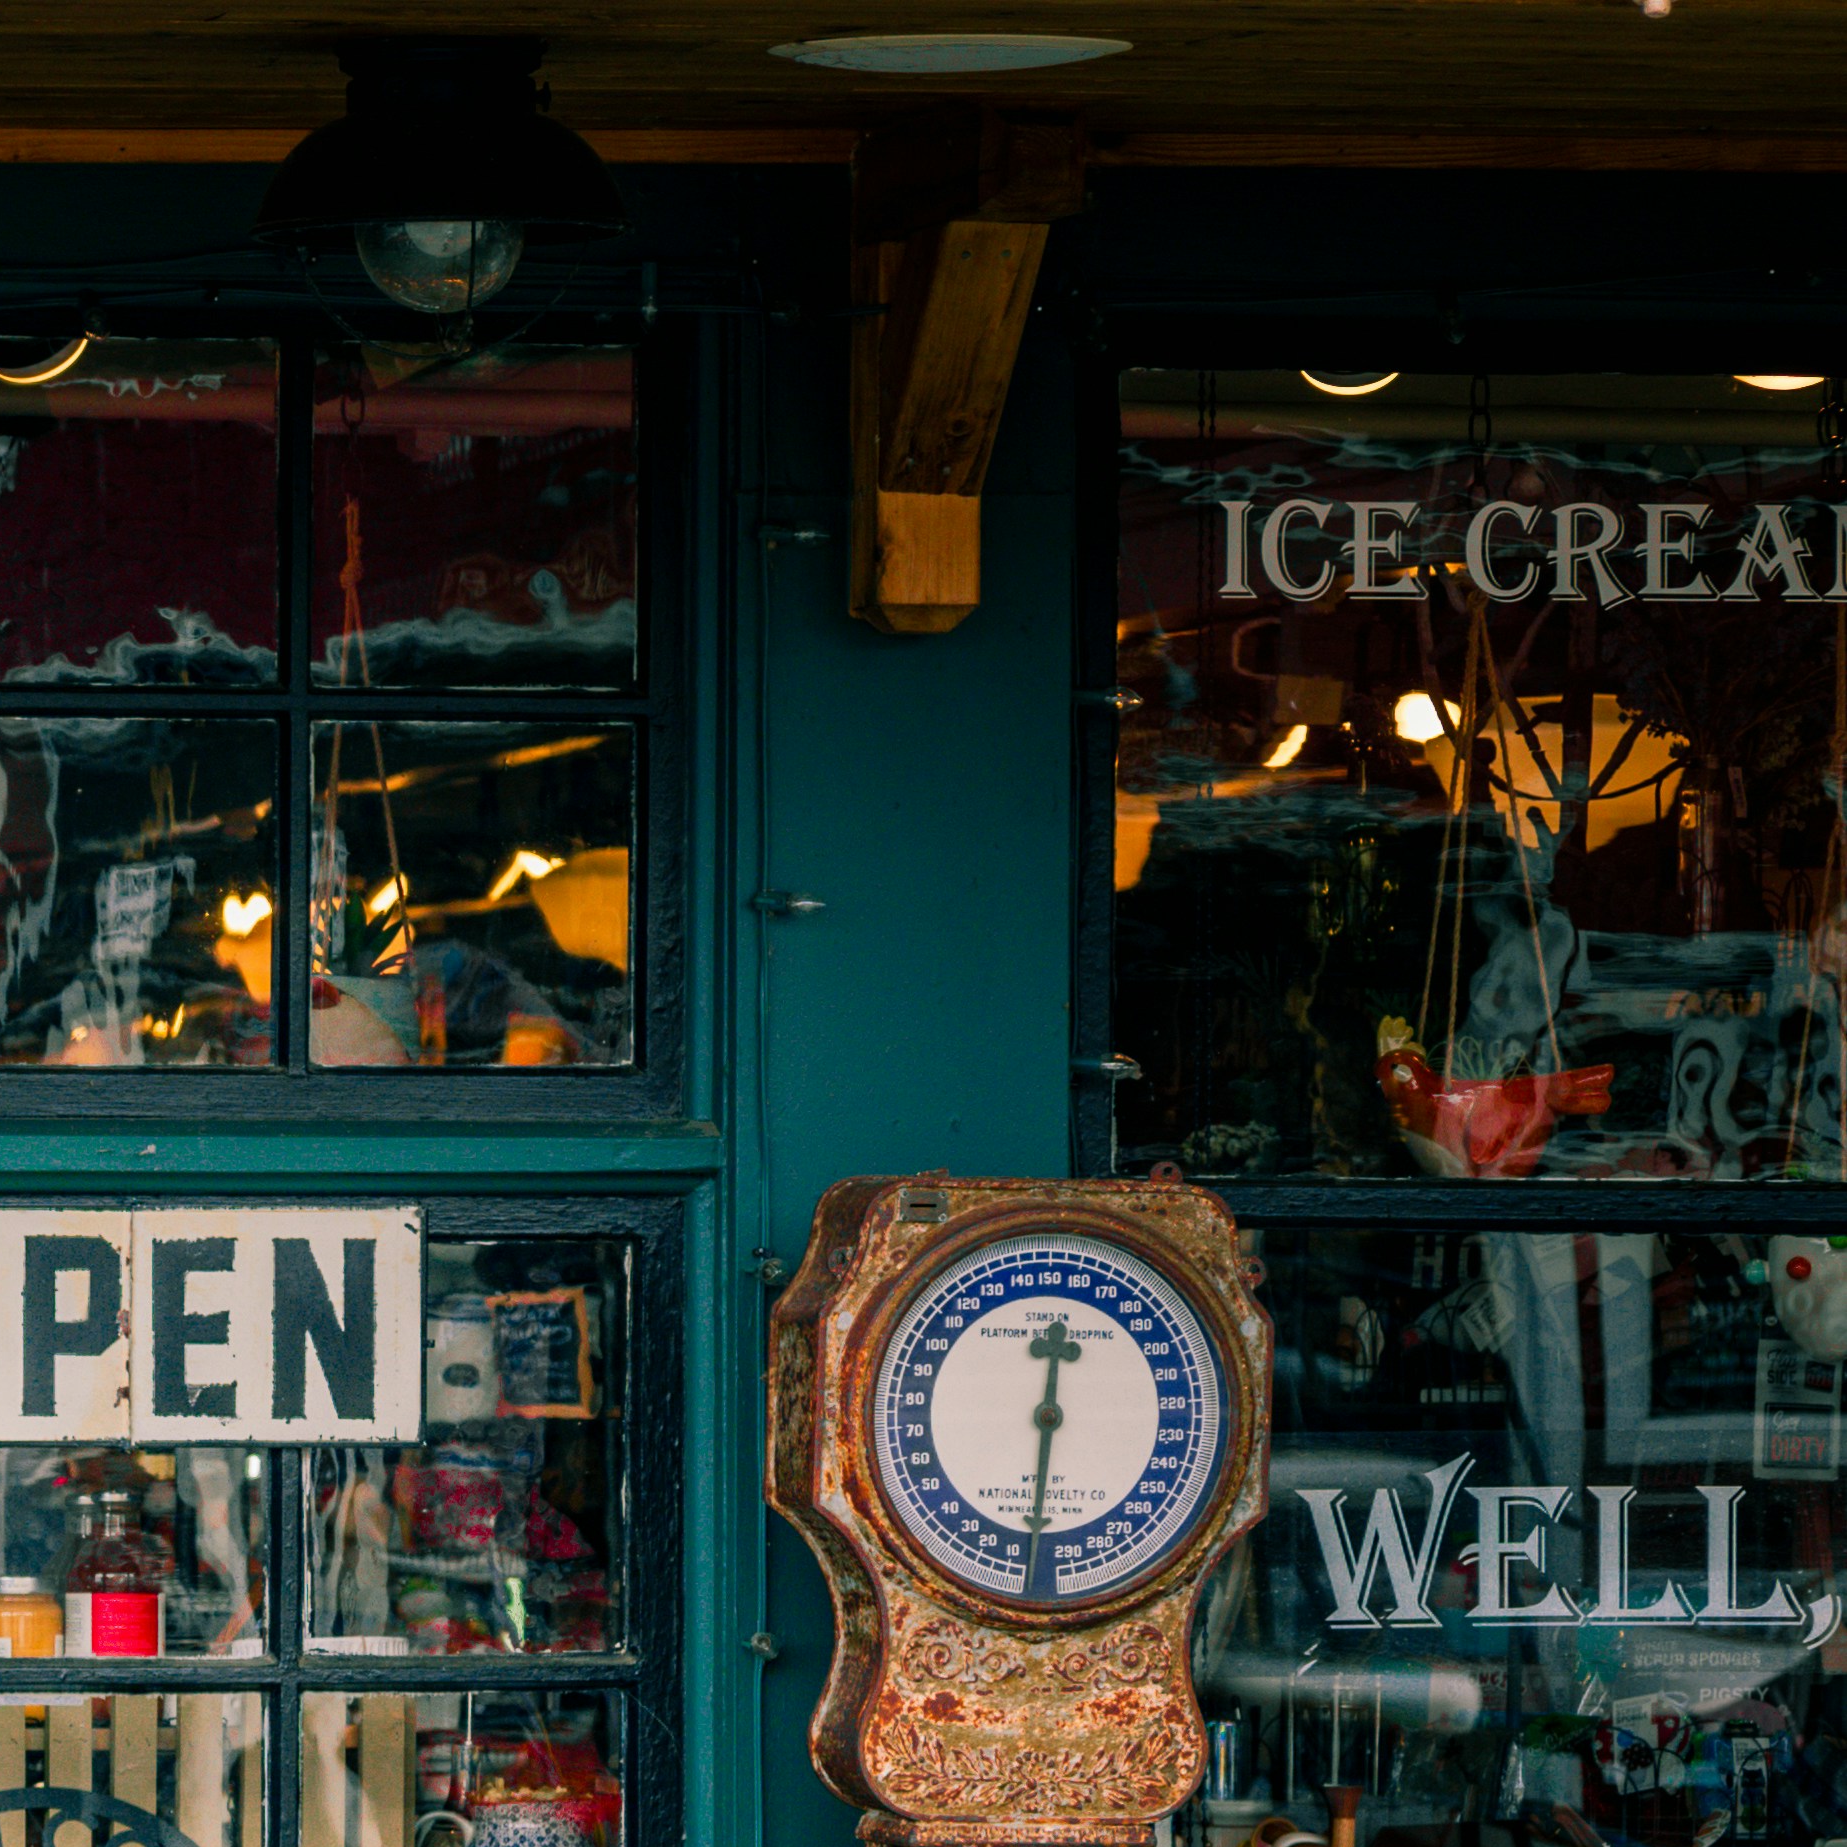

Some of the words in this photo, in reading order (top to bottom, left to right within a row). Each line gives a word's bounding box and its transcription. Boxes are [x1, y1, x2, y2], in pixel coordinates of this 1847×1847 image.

[1218, 499, 1428, 601] ICE
[1465, 499, 1847, 611] CREA
[1011, 1274, 1033, 1287] 140
[1039, 1272, 1061, 1285] 150
[1067, 1274, 1090, 1287] 160
[957, 1298, 980, 1310] 120
[1120, 1301, 1141, 1313] 180
[1025, 1312, 1055, 1322] STAND
[1058, 1312, 1069, 1322] ON
[1130, 1319, 1152, 1331] 190
[981, 1328, 1028, 1339] PLATFORM
[926, 1338, 948, 1350] 100
[1144, 1342, 1169, 1355] 200
[1155, 1368, 1177, 1380] 210
[906, 1392, 925, 1405] 80
[1160, 1397, 1185, 1409] 220
[1159, 1428, 1184, 1441] 230
[1771, 1436, 1825, 1461] DIRTY
[911, 1452, 930, 1465] 60
[1151, 1457, 1176, 1469] 240
[1052, 1475, 1065, 1484] BY
[979, 1488, 1032, 1500] NATIONAL
[1045, 1489, 1085, 1500] OVELTY
[941, 1501, 958, 1513] 40
[1124, 1501, 1151, 1514] 260
[979, 1534, 997, 1546] 20
[1087, 1536, 1113, 1548] 280
[1007, 1544, 1019, 1556] 10
[1055, 1545, 1082, 1558] 290
[1297, 1452, 1842, 1650] WELL,
[1699, 1687, 1769, 1701] PIGSTY
